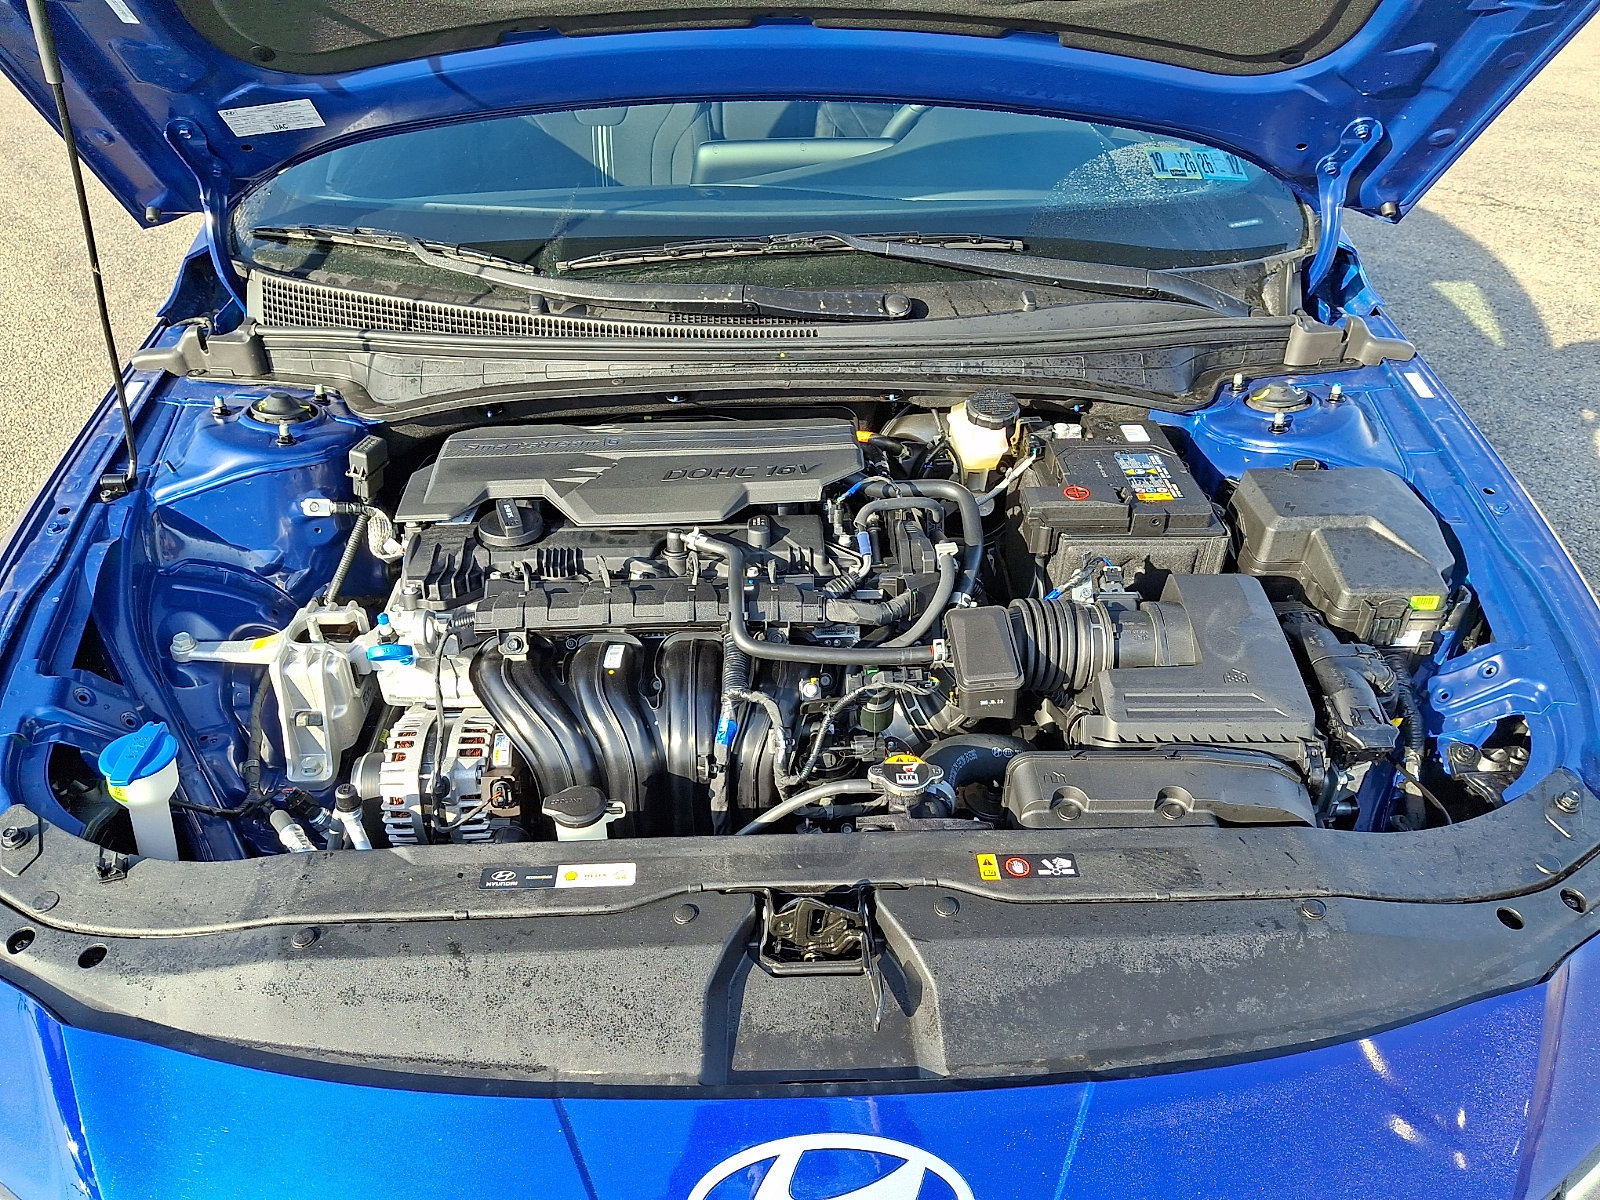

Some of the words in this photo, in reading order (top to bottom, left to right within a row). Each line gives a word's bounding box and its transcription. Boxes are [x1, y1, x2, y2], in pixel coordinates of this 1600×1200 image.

[1150, 152, 1168, 173] 12
[1180, 152, 1197, 174] 26
[1197, 153, 1215, 174] 26
[1226, 154, 1243, 175] 12
[661, 465, 760, 482] DOHC
[766, 462, 823, 478] 16V
